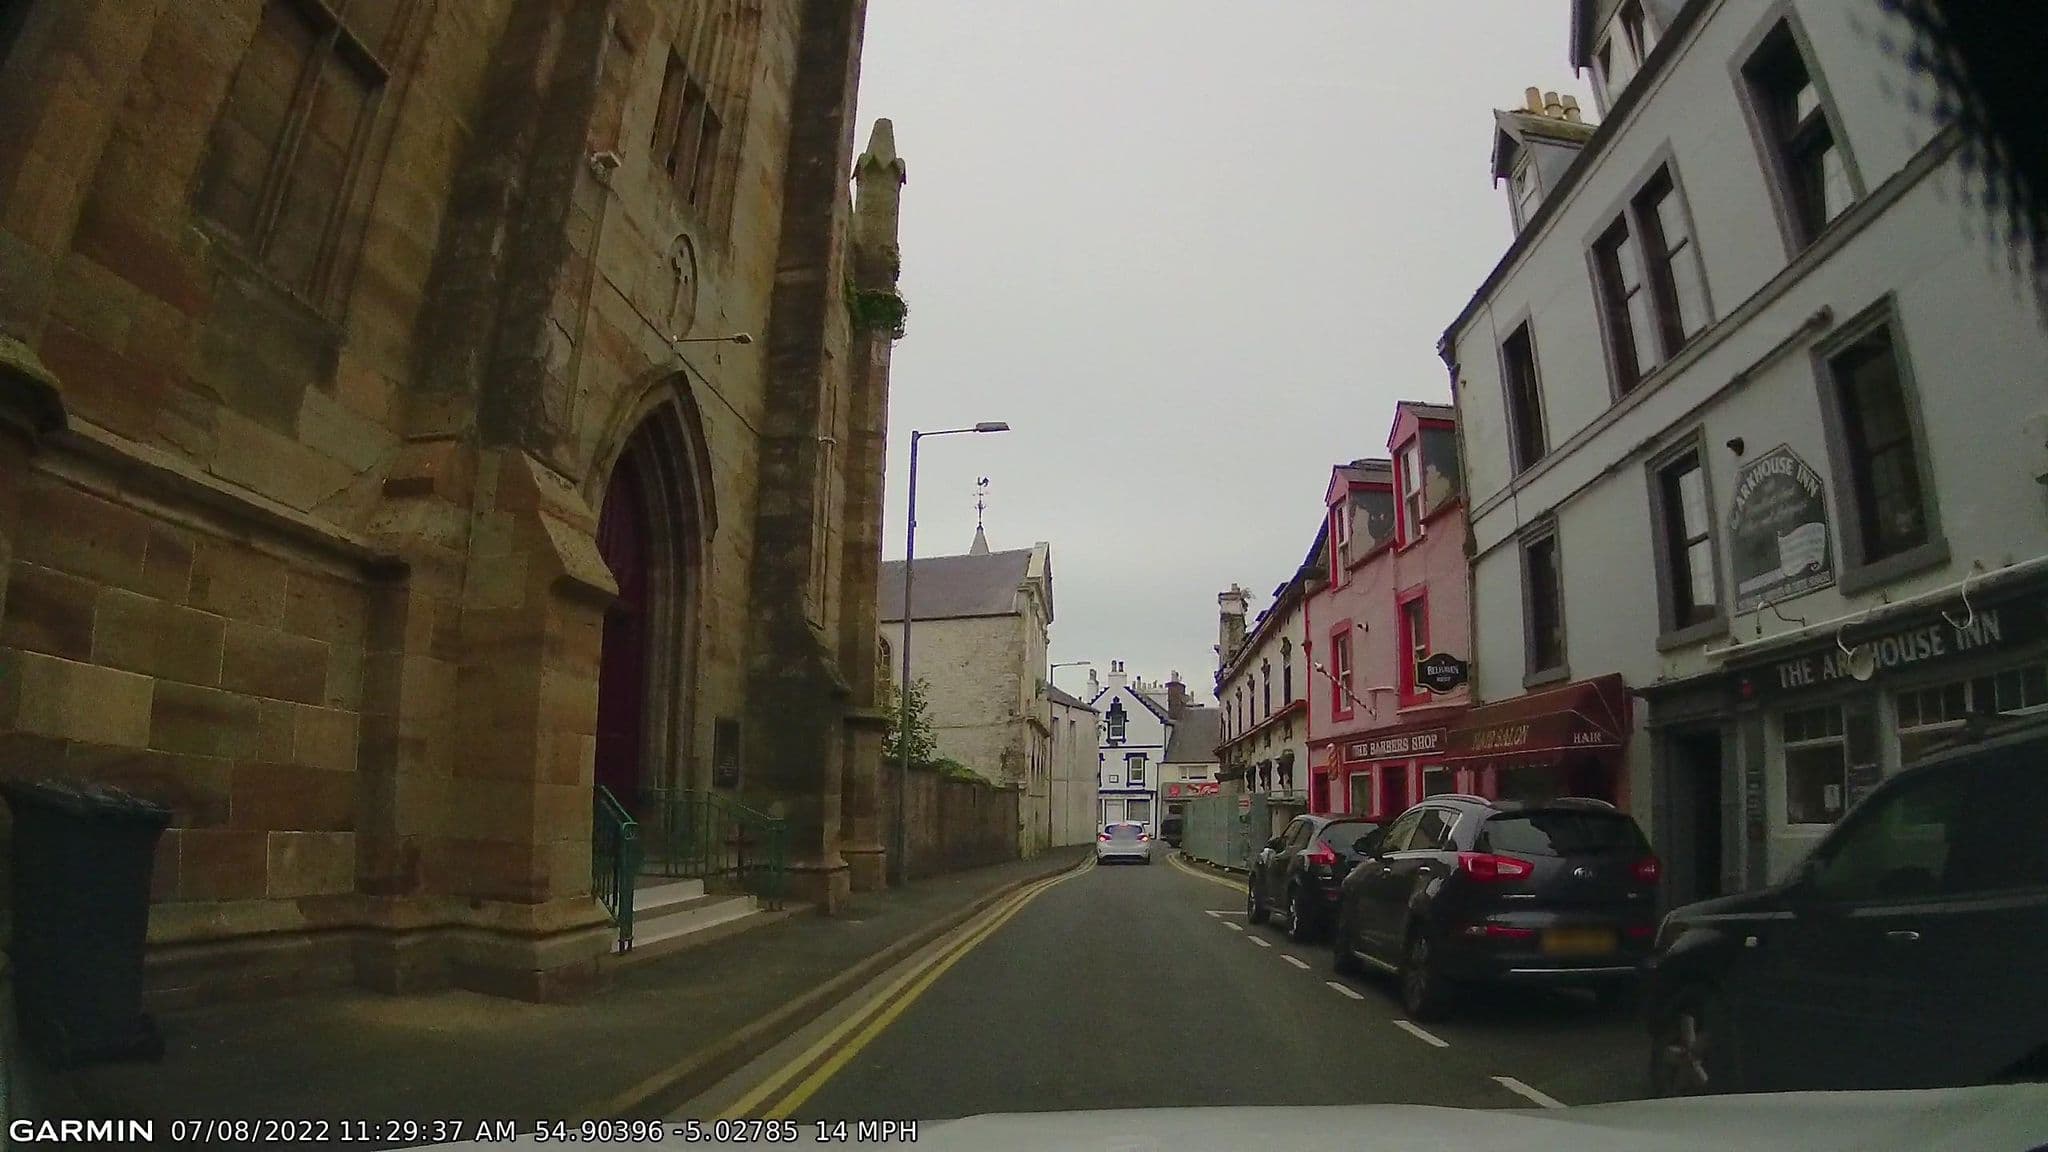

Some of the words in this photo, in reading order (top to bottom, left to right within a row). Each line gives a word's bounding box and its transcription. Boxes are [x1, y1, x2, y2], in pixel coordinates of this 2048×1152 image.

[1796, 464, 1820, 498] INN
[1778, 660, 1814, 688] THE
[1823, 625, 1946, 680] ARHOUSE
[1953, 609, 2001, 651] INN
[1370, 738, 1409, 756] BARBERS
[1412, 734, 1438, 751] SHOP
[1573, 732, 1601, 744] HAIR
